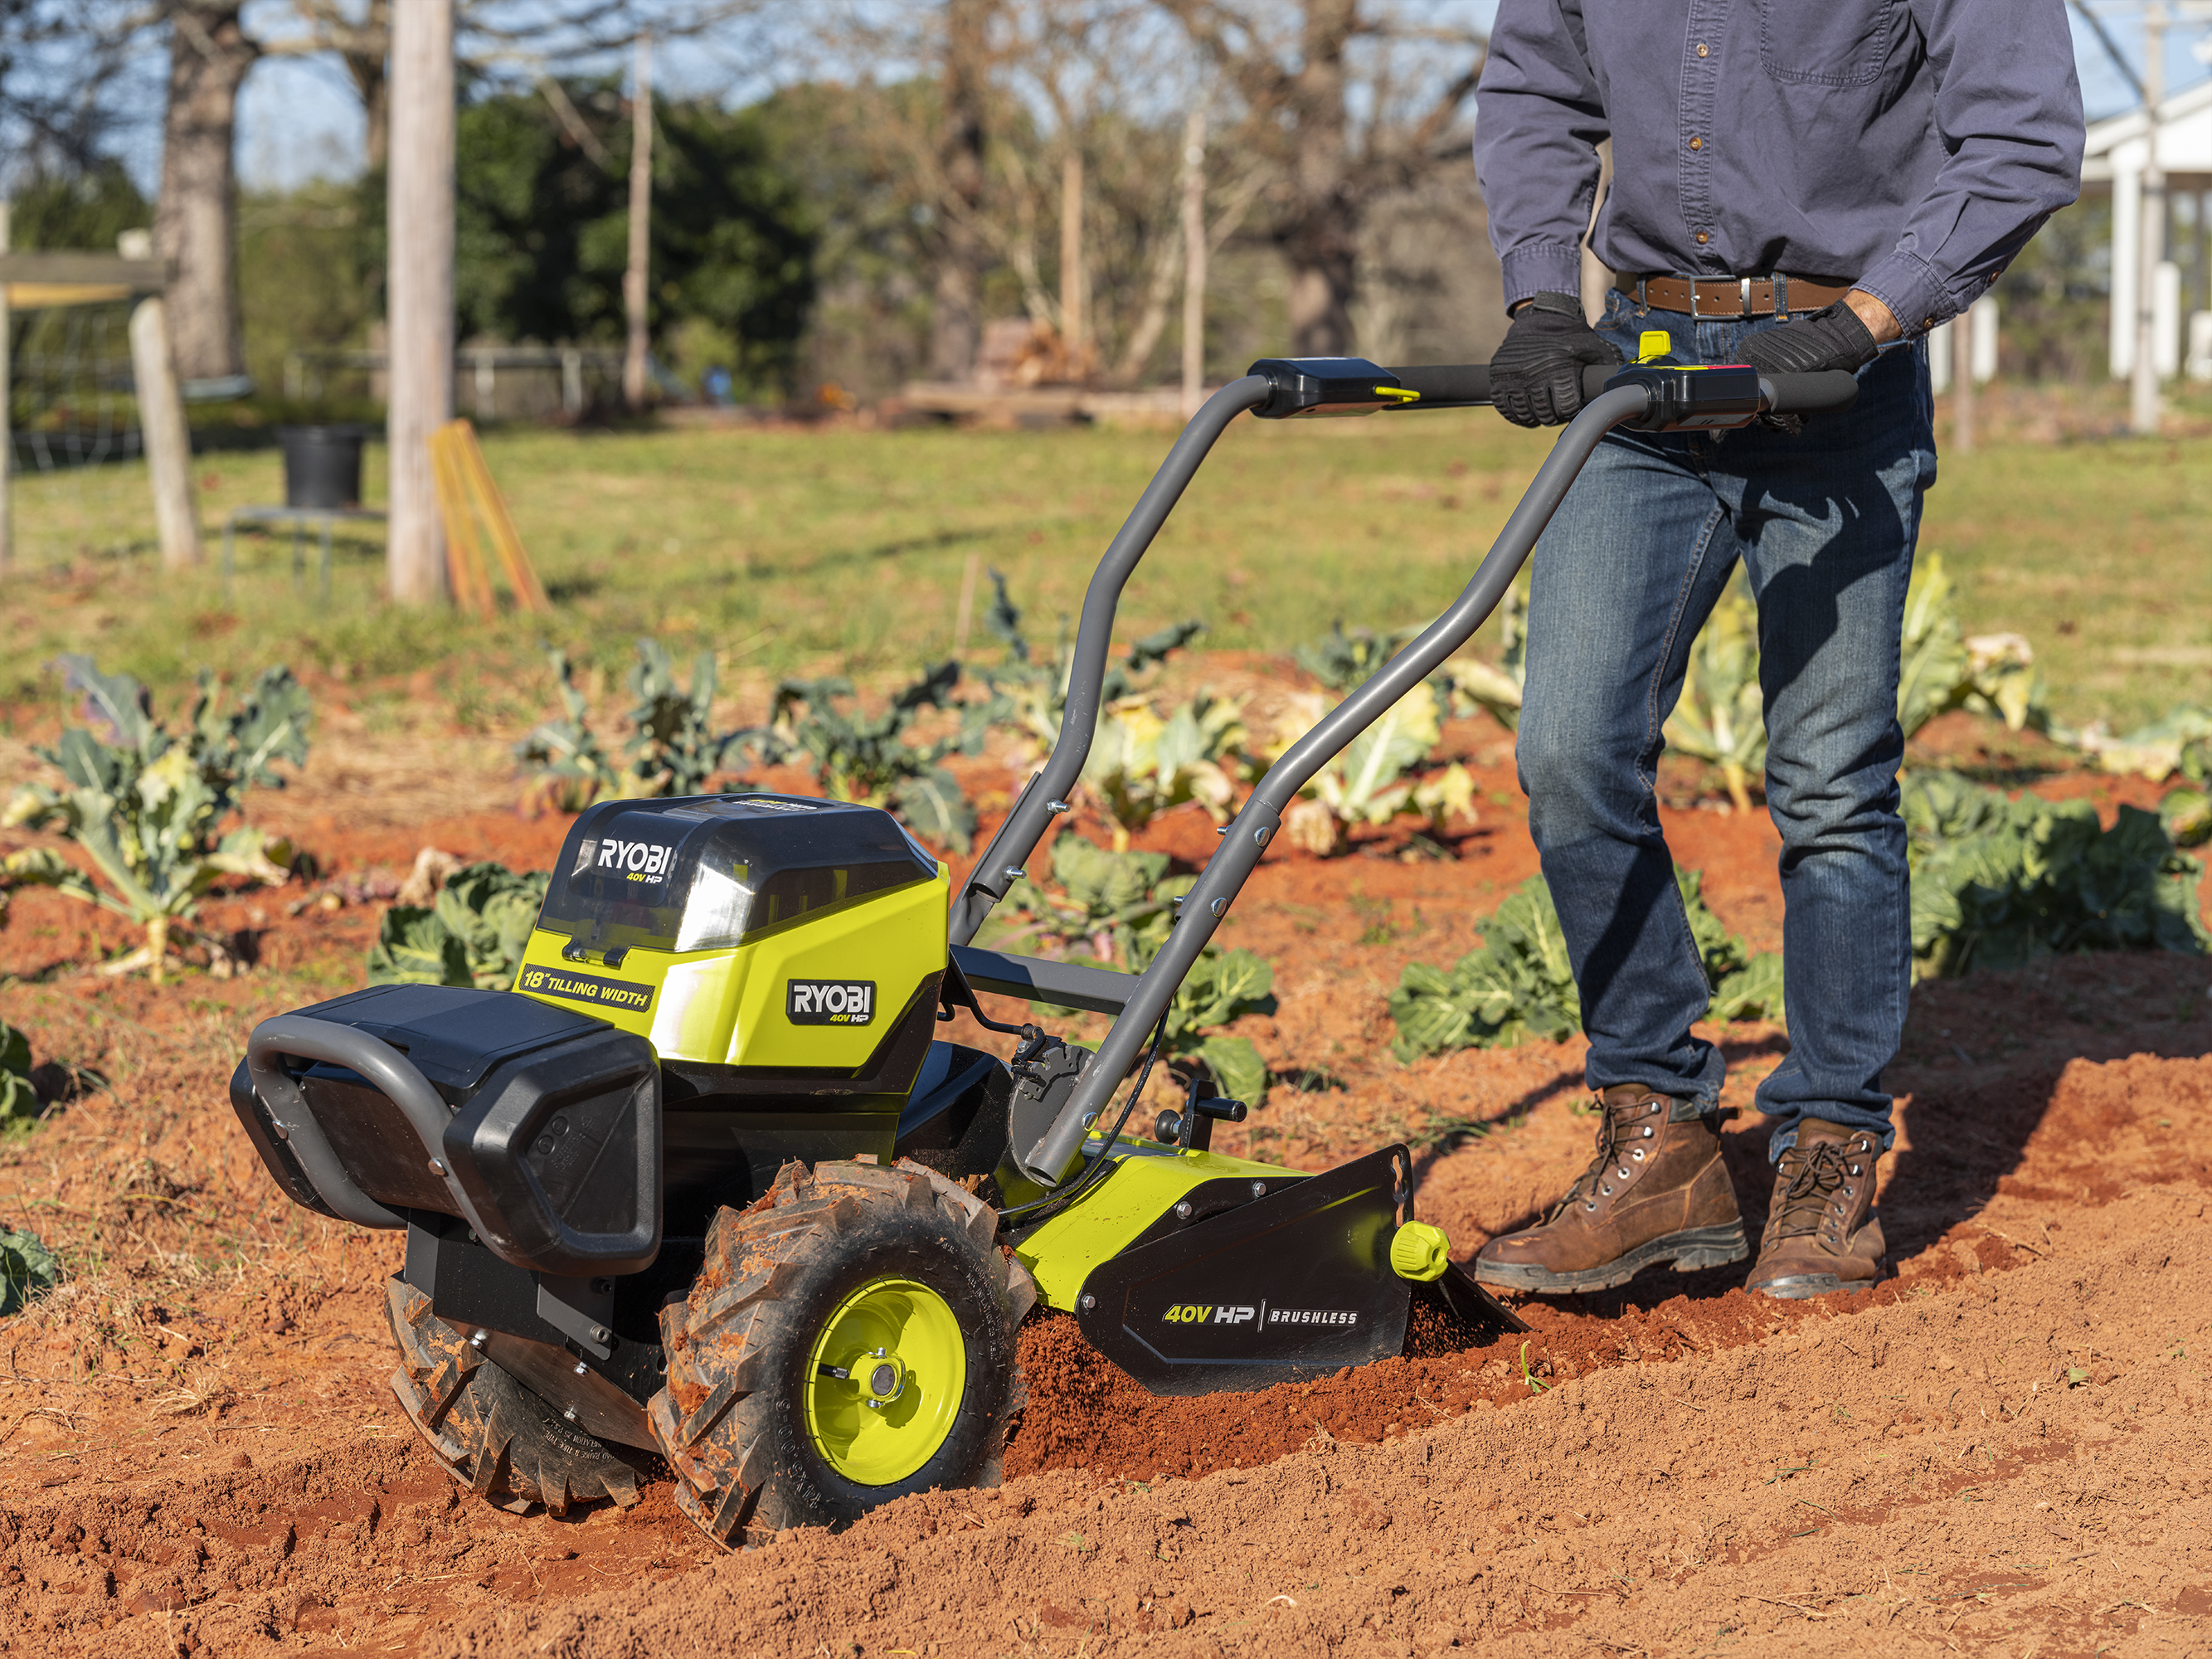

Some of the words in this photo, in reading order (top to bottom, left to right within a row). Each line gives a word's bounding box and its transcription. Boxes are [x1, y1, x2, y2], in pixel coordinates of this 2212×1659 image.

[597, 839, 673, 874] RYOBI
[626, 872, 646, 882] 40V
[645, 874, 663, 884] HP
[547, 977, 599, 997] TILLING
[600, 986, 649, 1007] WIDTH
[794, 985, 871, 1014] RYOBI
[829, 1014, 851, 1023] 40V
[850, 1014, 869, 1023] HP
[1164, 1306, 1213, 1323] 40V
[1213, 1306, 1256, 1324] HP
[1270, 1311, 1358, 1325] BRUSHLESS
